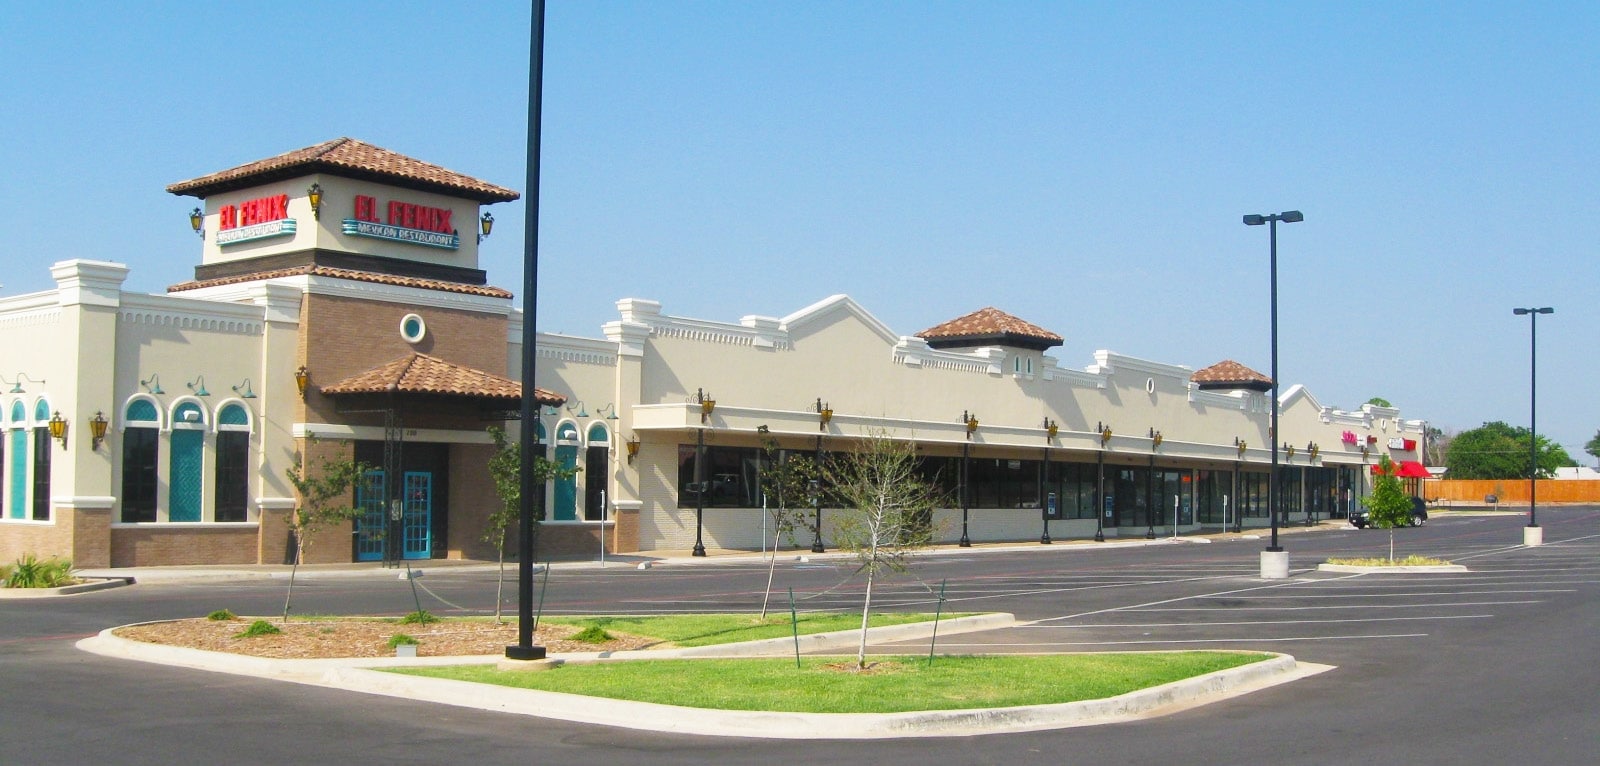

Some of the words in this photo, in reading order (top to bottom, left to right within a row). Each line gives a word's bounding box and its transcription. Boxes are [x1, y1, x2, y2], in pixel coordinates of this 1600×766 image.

[219, 203, 236, 231] EL
[239, 194, 288, 227] FENIX
[354, 195, 380, 222] EL
[388, 200, 453, 234] FENIX
[357, 223, 397, 238] MEXICAN
[398, 229, 454, 245] RESTAURANT
